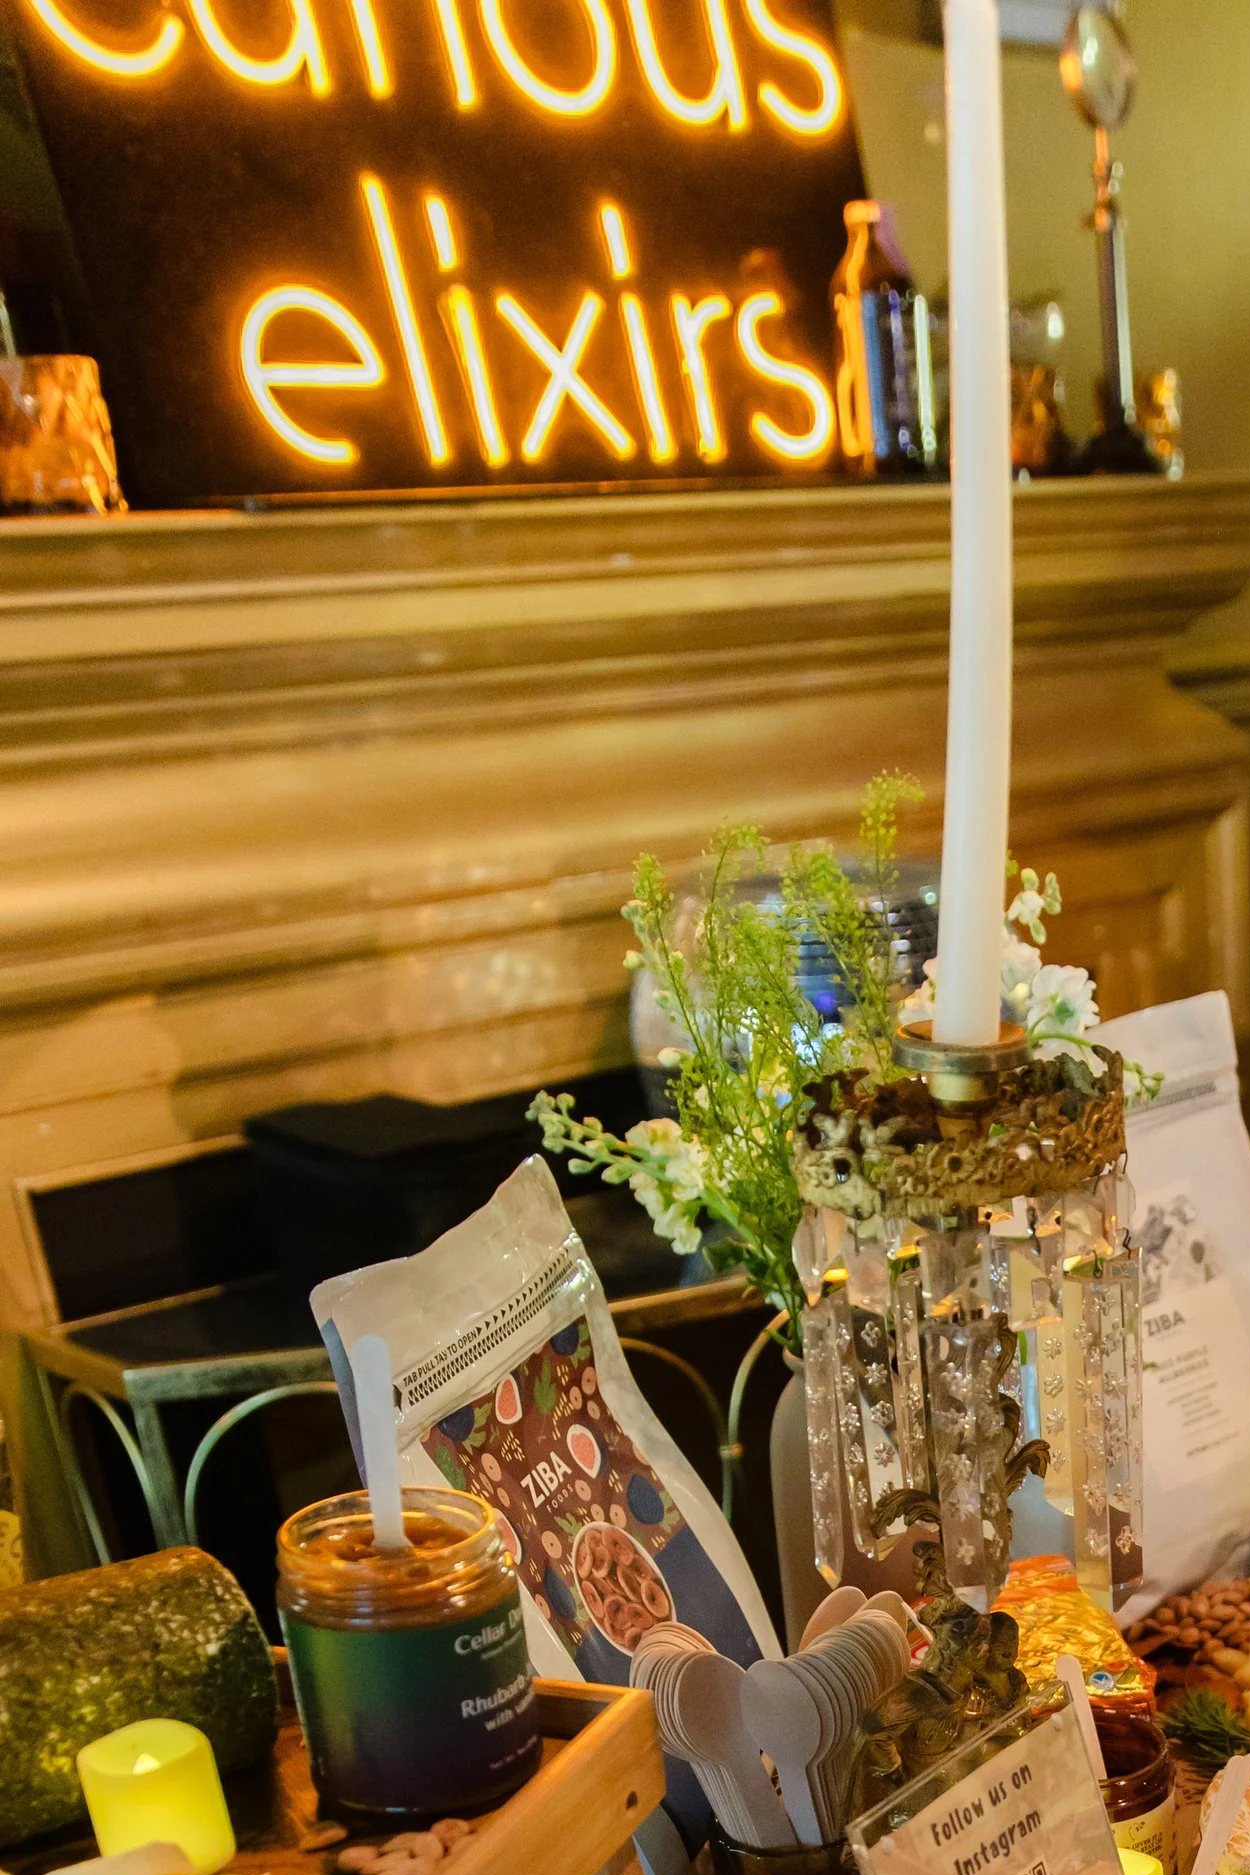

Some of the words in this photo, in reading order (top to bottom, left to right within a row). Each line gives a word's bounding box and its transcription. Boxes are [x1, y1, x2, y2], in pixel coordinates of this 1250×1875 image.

[240, 172, 835, 466] elixirs
[1143, 1309, 1186, 1337] ZIBA
[402, 1371, 418, 1387] TAB
[418, 1358, 436, 1377] PULL
[447, 1342, 456, 1356] TO
[457, 1329, 477, 1349] OPEN
[520, 1451, 572, 1508] ZIBA
[546, 1484, 573, 1514] FOODS
[454, 1621, 507, 1656] Cellar
[930, 1797, 985, 1847] Follow
[988, 1780, 1008, 1808] us
[1011, 1762, 1032, 1791] on
